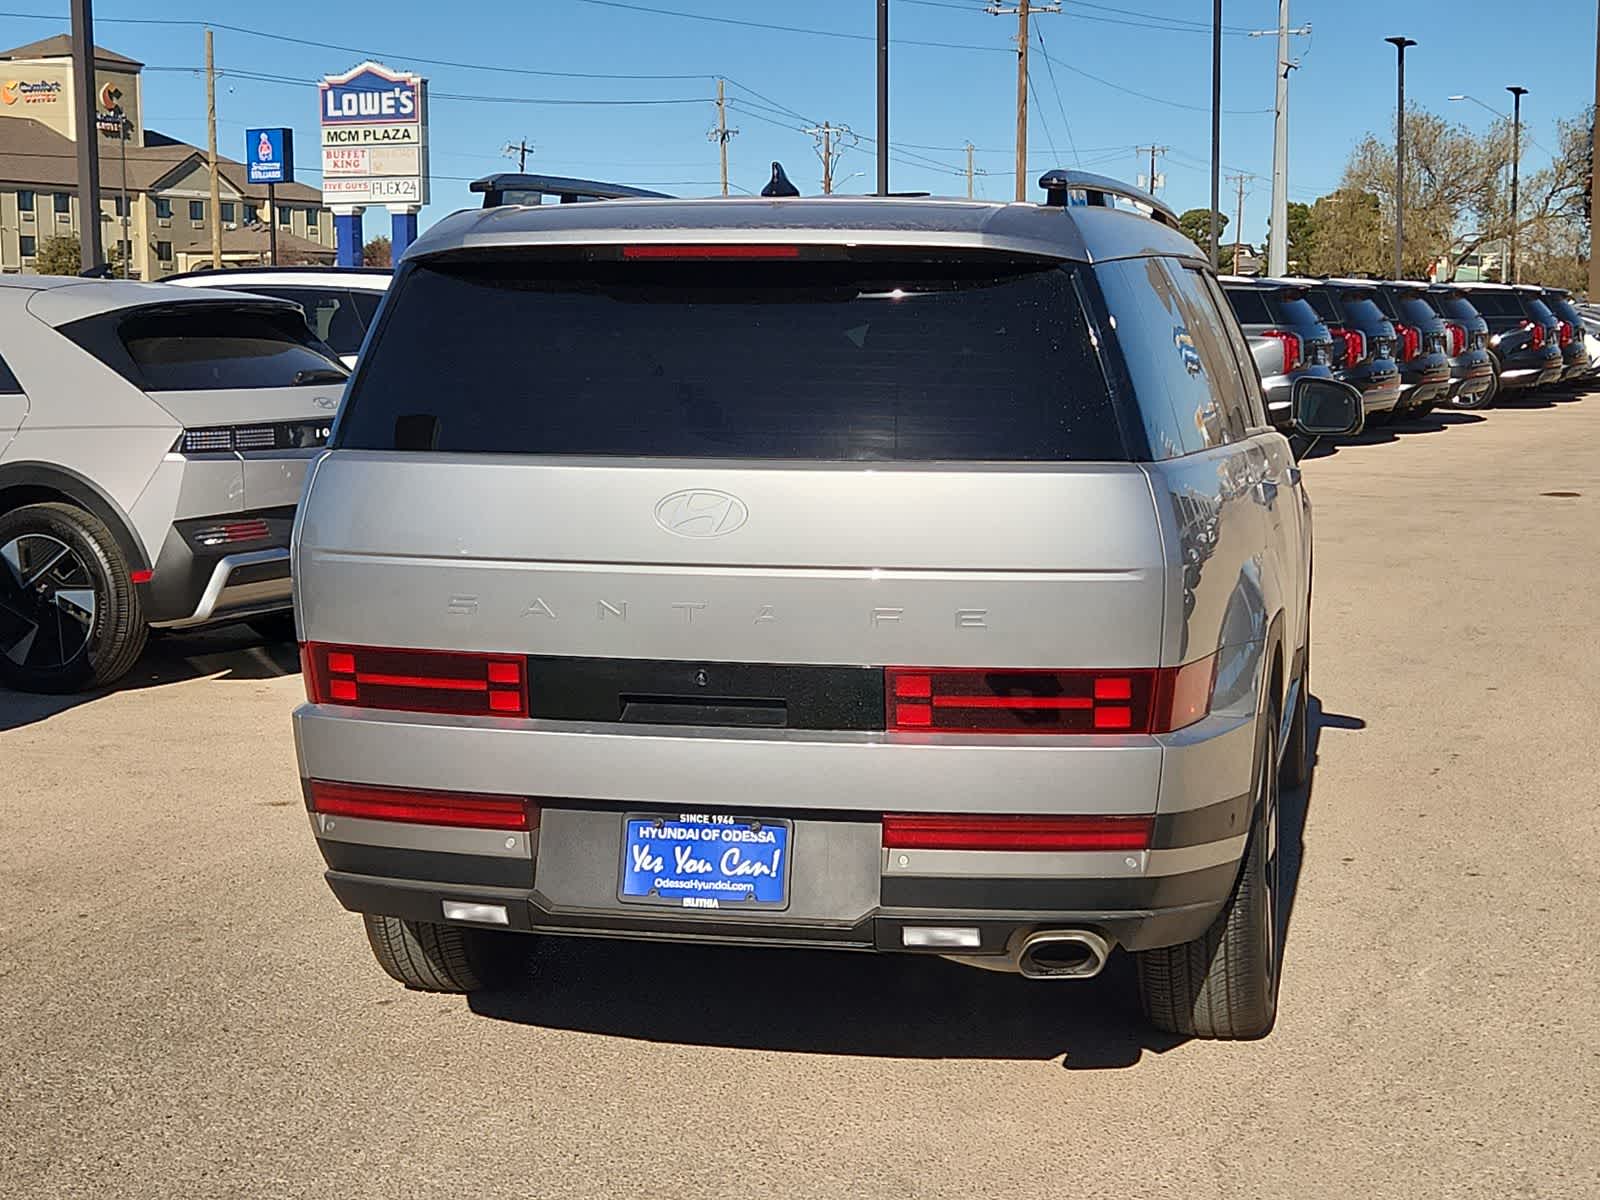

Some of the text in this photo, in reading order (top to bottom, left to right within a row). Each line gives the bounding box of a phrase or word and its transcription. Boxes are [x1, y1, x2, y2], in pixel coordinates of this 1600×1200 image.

[326, 87, 414, 117] LOWE'S
[327, 128, 411, 143] MCM PLAZA
[326, 150, 367, 159] BUFFET
[333, 160, 361, 168] KING
[447, 592, 989, 631] SANTA FE
[679, 814, 735, 825] SINCE 1946
[639, 827, 776, 843] HYUNDAI OF ODESSA
[632, 844, 781, 878] Yes You Can!
[654, 878, 754, 892] OdessaHyundai.com
